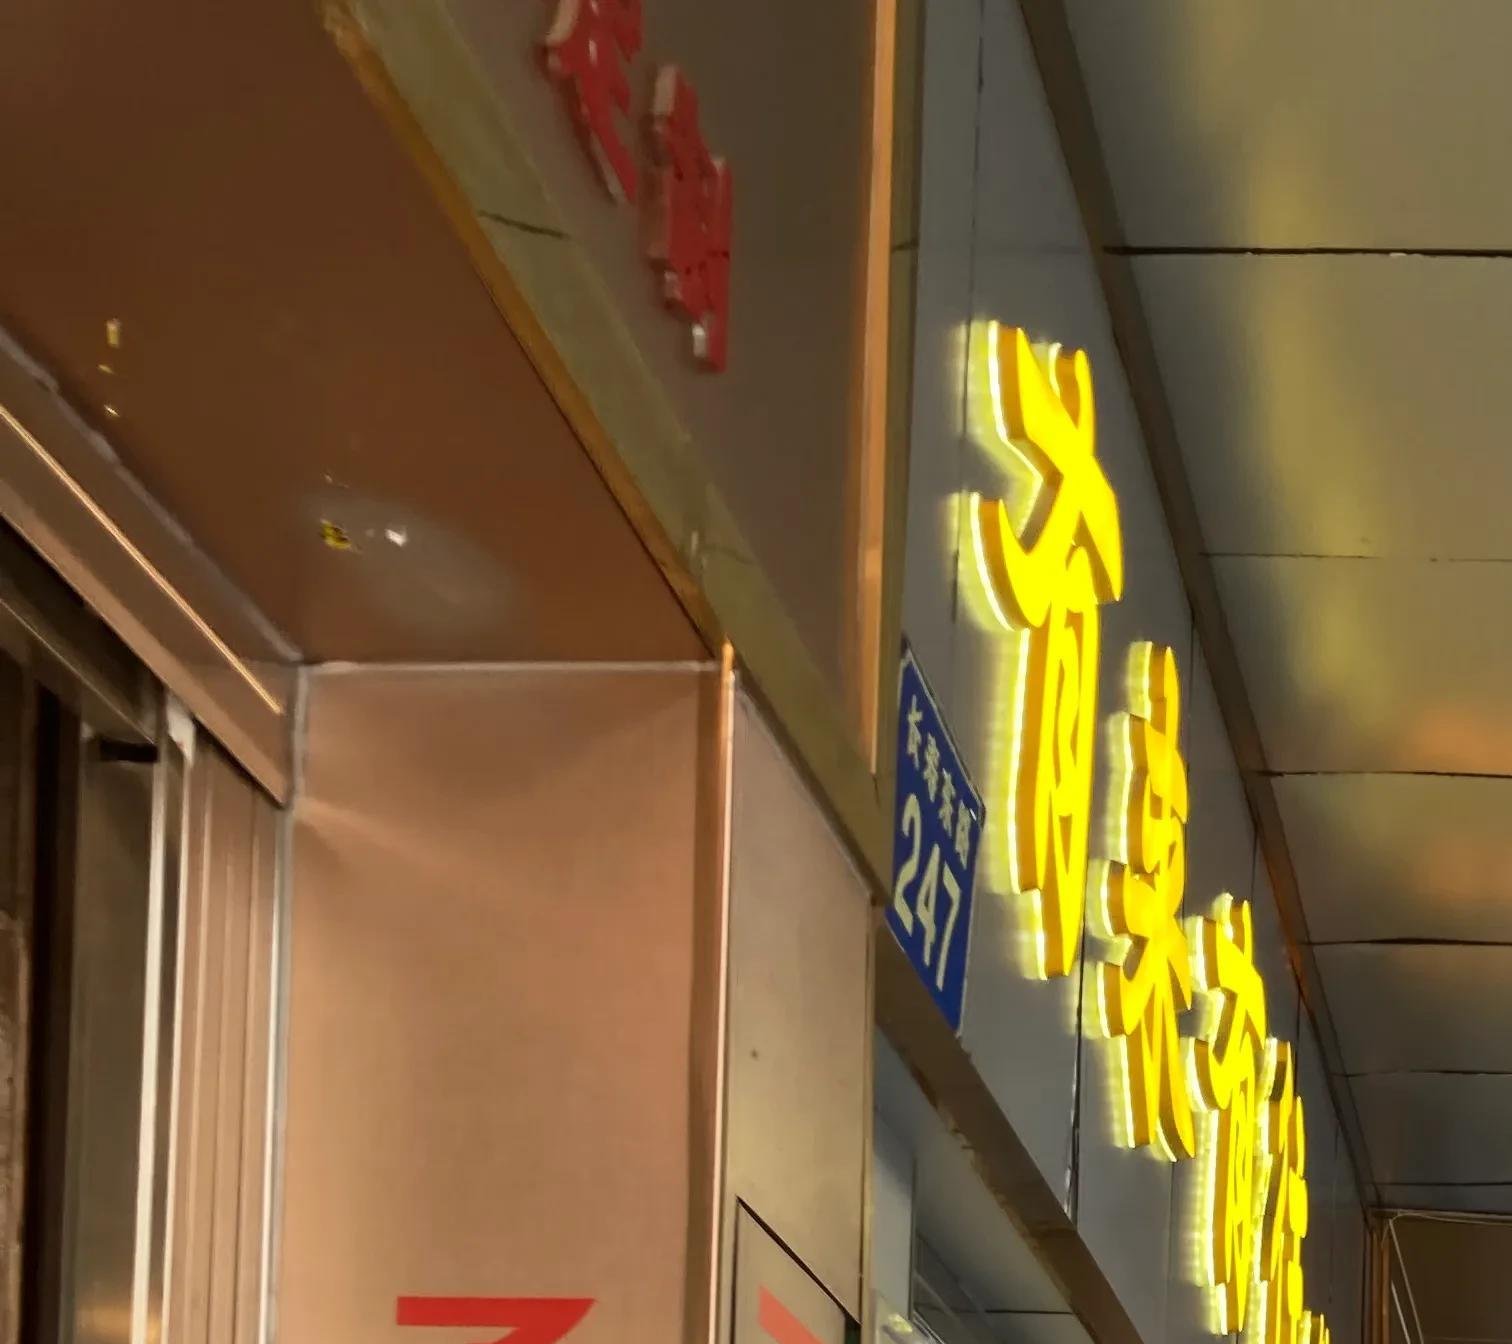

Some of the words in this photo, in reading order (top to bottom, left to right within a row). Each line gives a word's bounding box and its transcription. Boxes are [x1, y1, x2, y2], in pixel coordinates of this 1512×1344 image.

[905, 692, 968, 866] 长寿东路
[893, 797, 962, 993] 247
